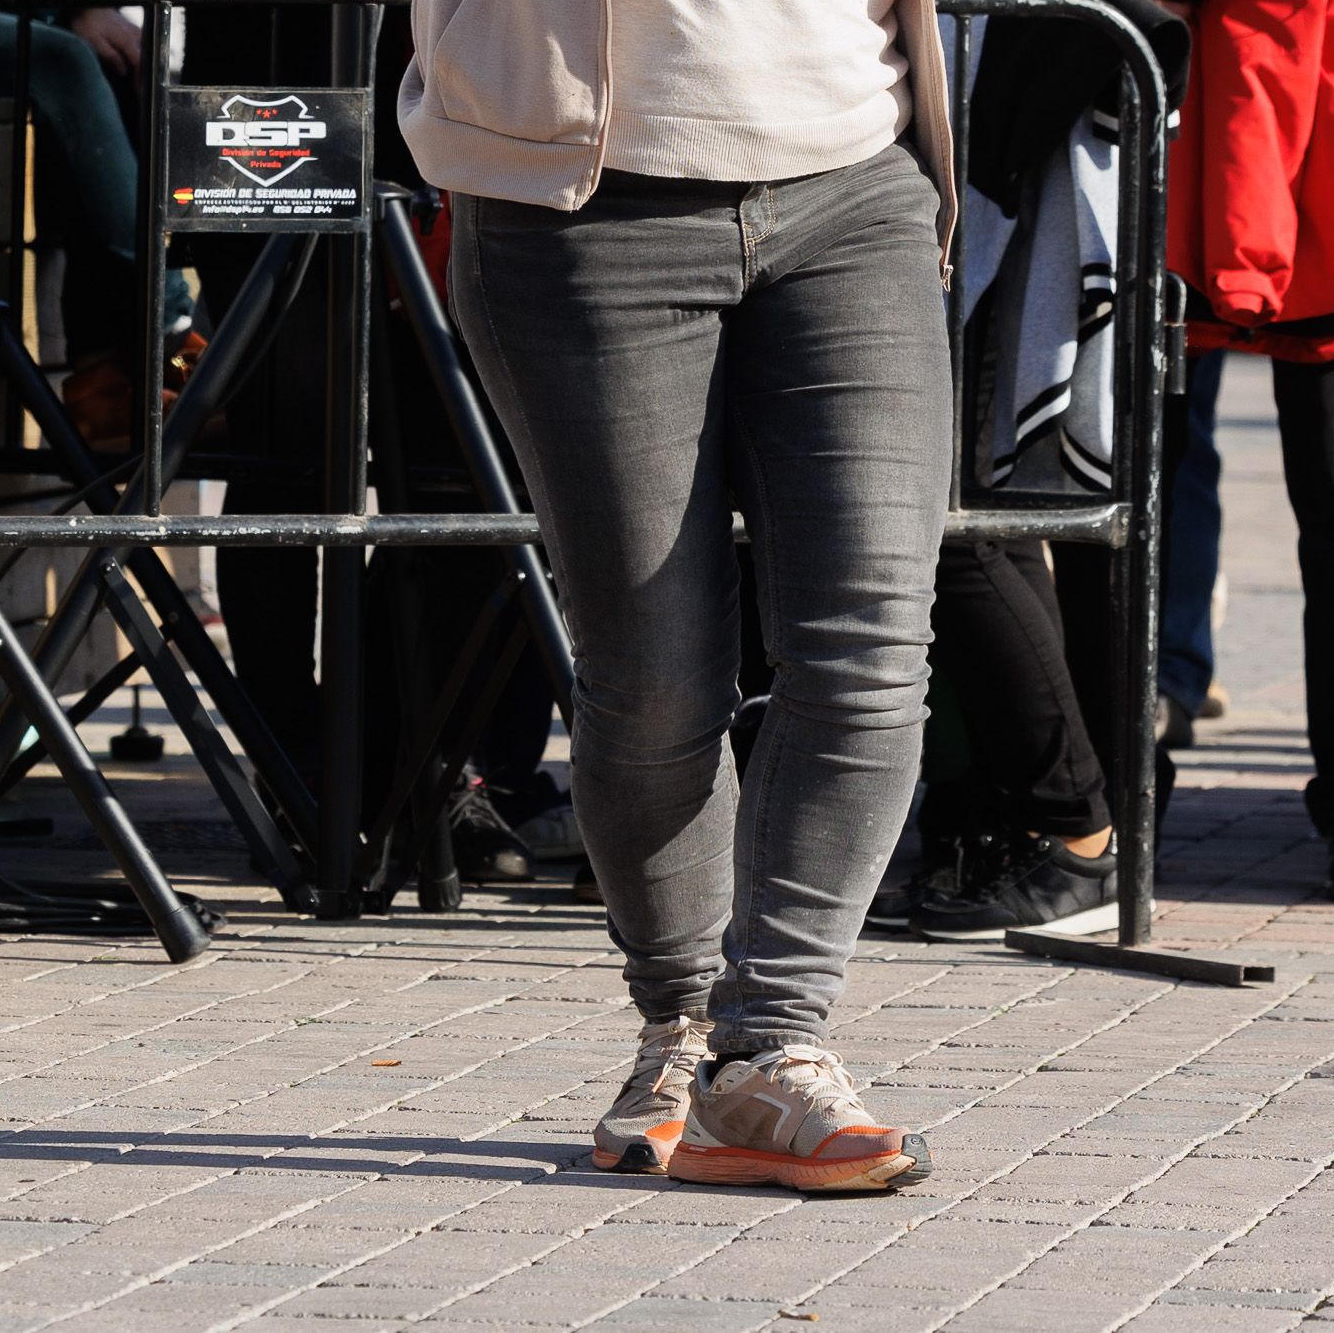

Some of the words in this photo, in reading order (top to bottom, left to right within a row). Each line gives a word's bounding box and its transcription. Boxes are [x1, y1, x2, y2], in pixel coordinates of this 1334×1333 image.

[206, 121, 327, 146] DSP
[256, 148, 267, 157] de
[269, 148, 310, 158] Seguridad
[250, 160, 282, 169] Privada
[238, 188, 253, 199] DE
[255, 188, 312, 199] SEGURIDAD
[313, 188, 357, 199] PRIVADA
